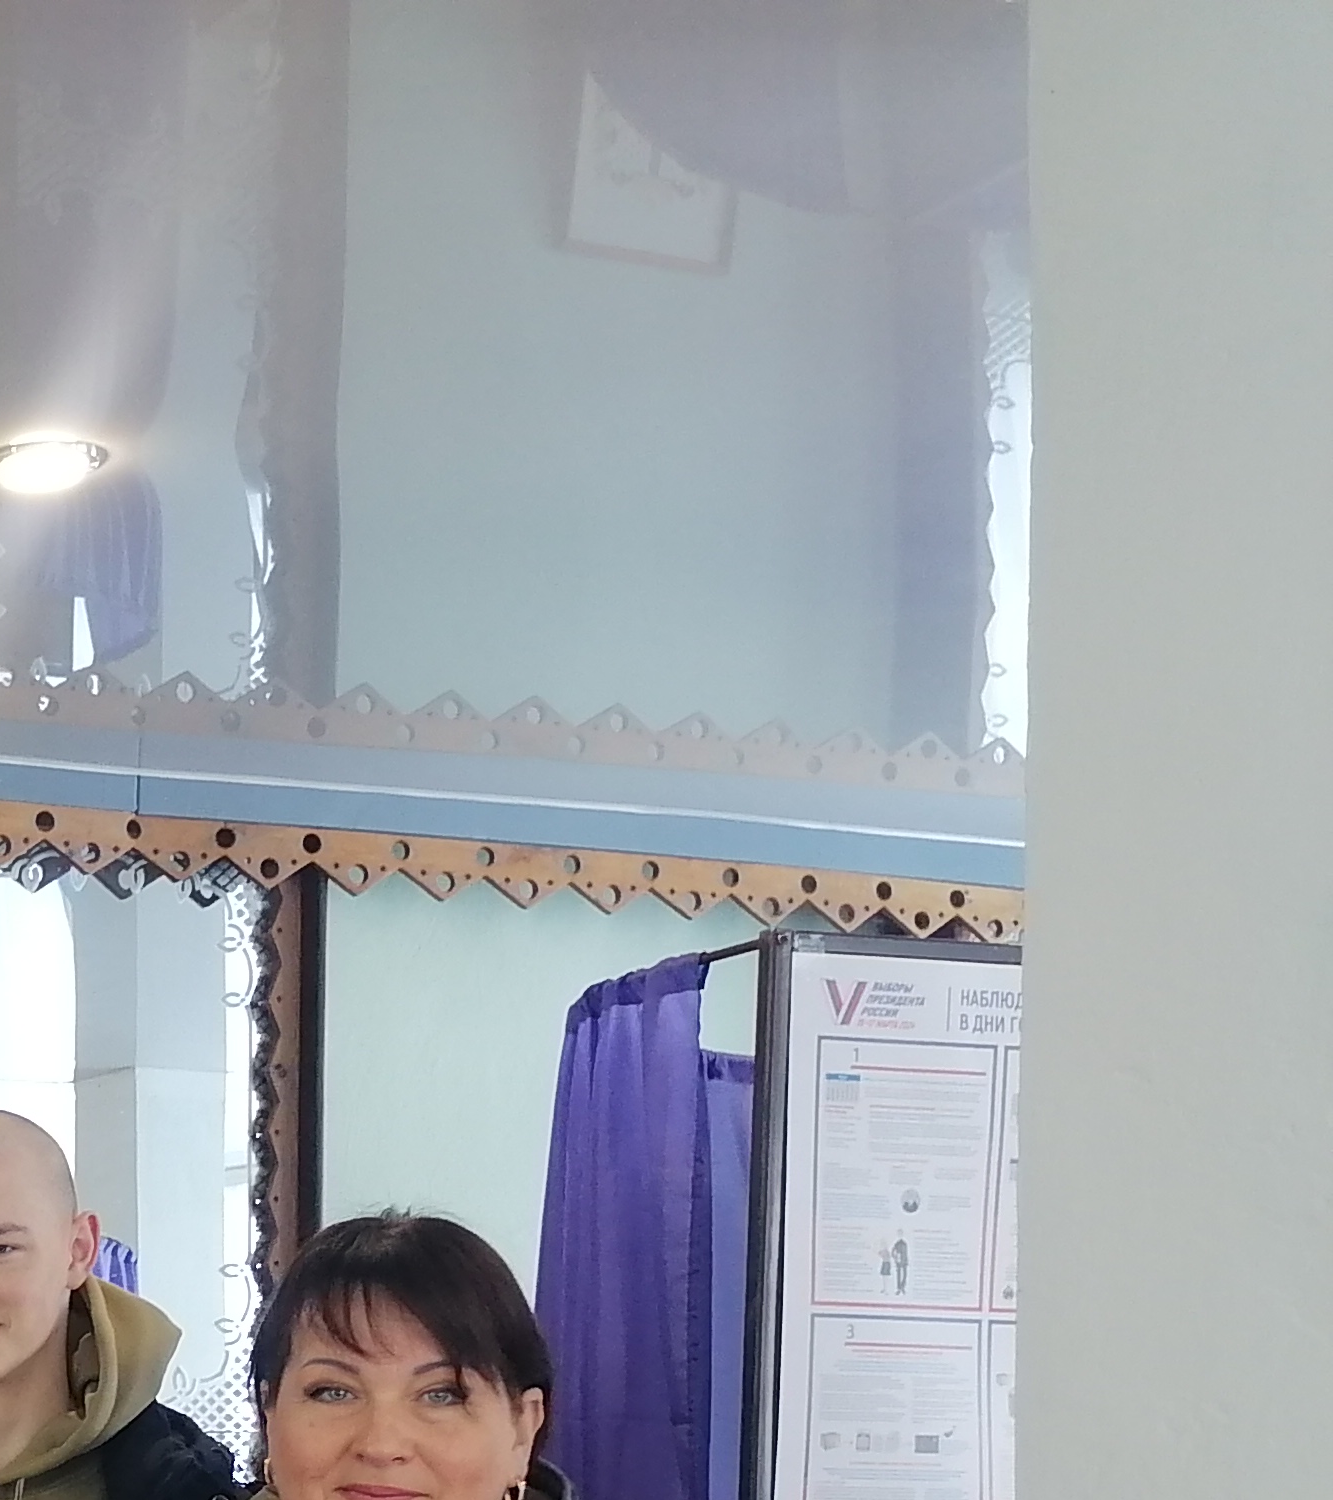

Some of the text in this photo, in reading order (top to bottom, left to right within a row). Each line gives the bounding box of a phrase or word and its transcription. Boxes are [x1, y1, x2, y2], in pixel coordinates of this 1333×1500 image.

[872, 982, 915, 993] ВЫБОРЫ
[865, 994, 926, 1006] ПРЕЗИДЕНТА
[860, 1006, 900, 1018] РОССИИ
[959, 1013, 1023, 1034] В ДНИ Г
[853, 1047, 860, 1062] 1
[845, 1323, 855, 1340] 3
